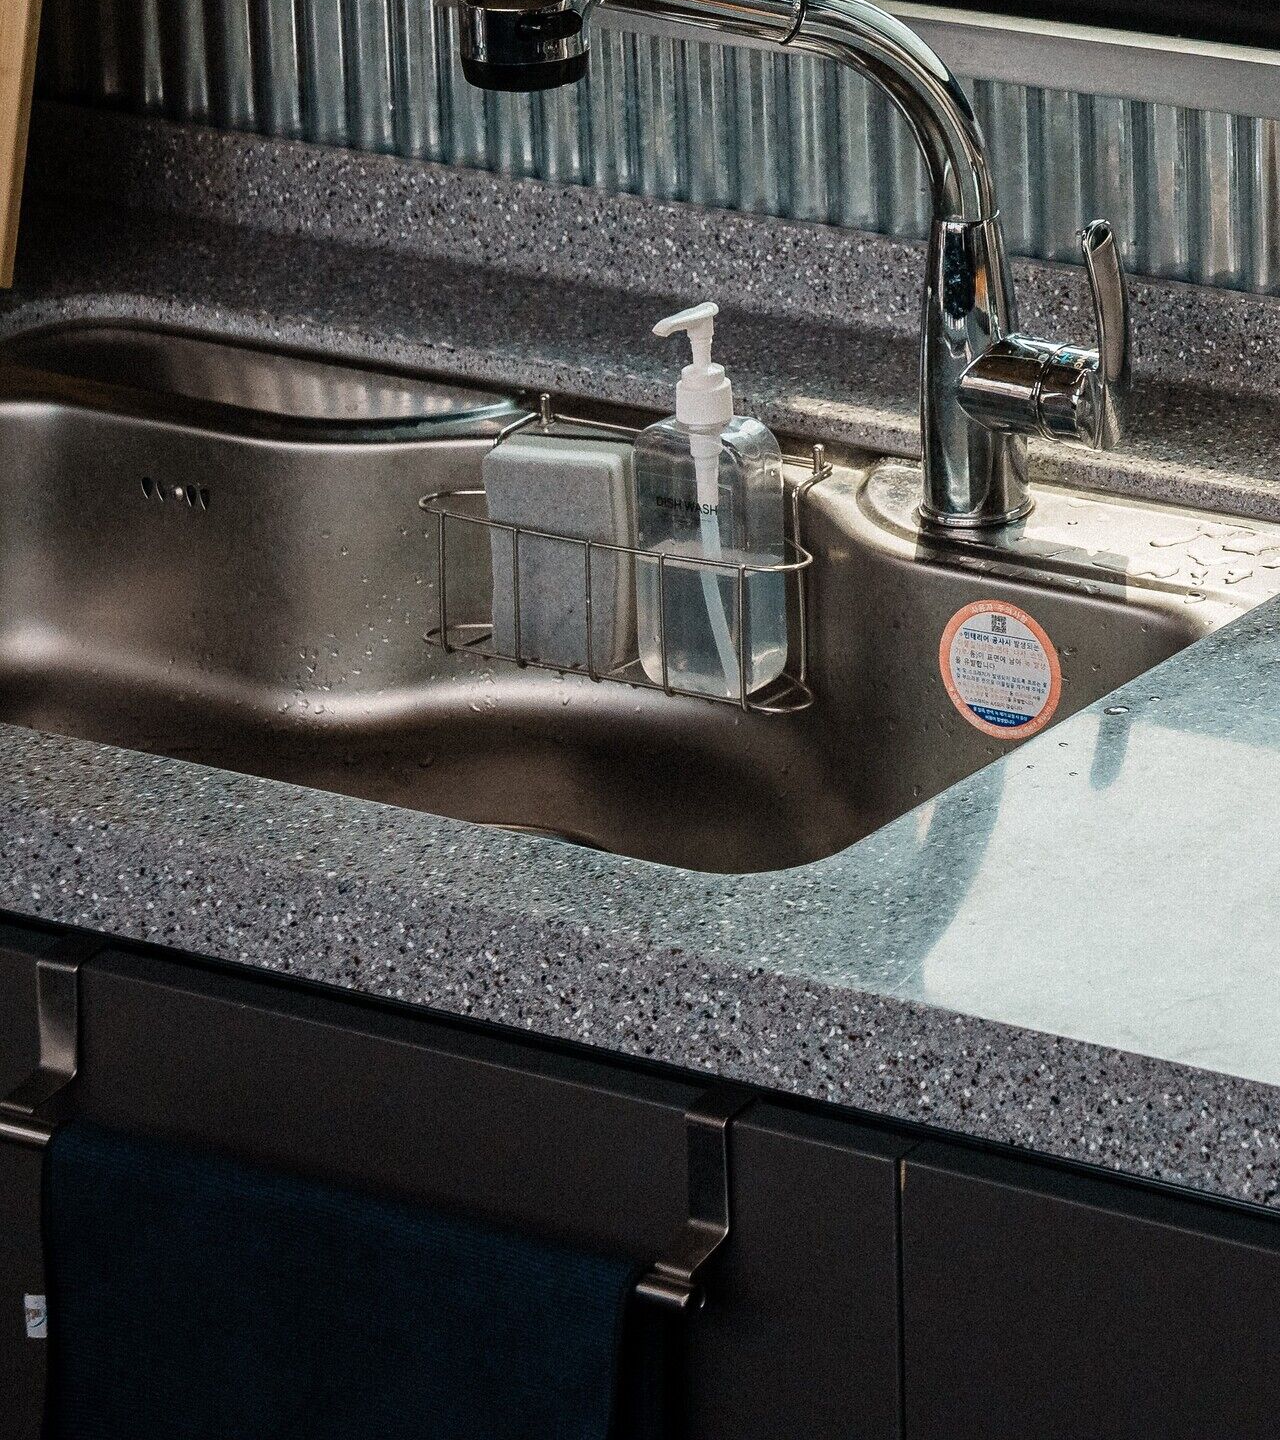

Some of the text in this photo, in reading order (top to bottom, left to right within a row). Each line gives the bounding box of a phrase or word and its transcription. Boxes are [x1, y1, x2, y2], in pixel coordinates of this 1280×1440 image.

[656, 496, 718, 516] DISH WASH
[963, 631, 990, 643] 인테리어
